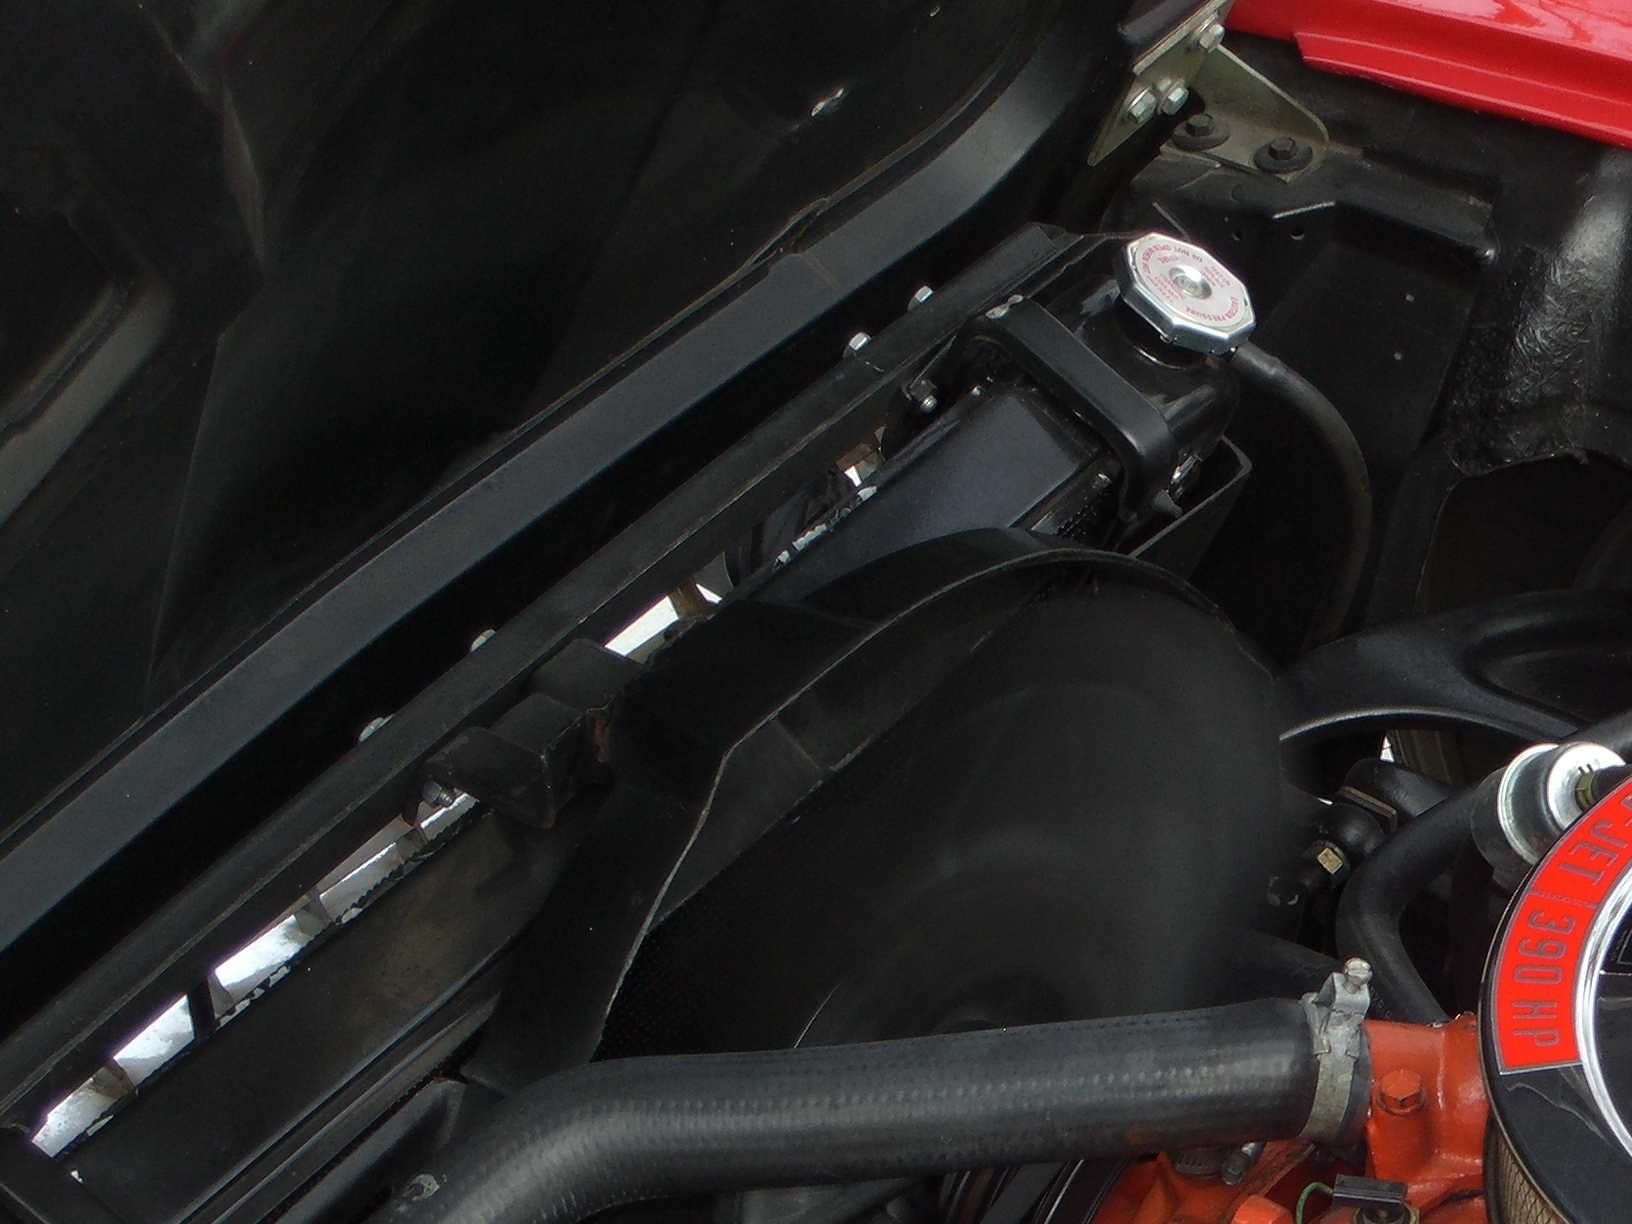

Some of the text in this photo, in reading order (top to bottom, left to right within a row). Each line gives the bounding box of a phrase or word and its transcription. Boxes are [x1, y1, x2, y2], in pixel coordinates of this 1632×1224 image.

[1187, 307, 1226, 322] PRESSURE
[1514, 909, 1572, 987] 390
[1512, 1001, 1559, 1047] HP
